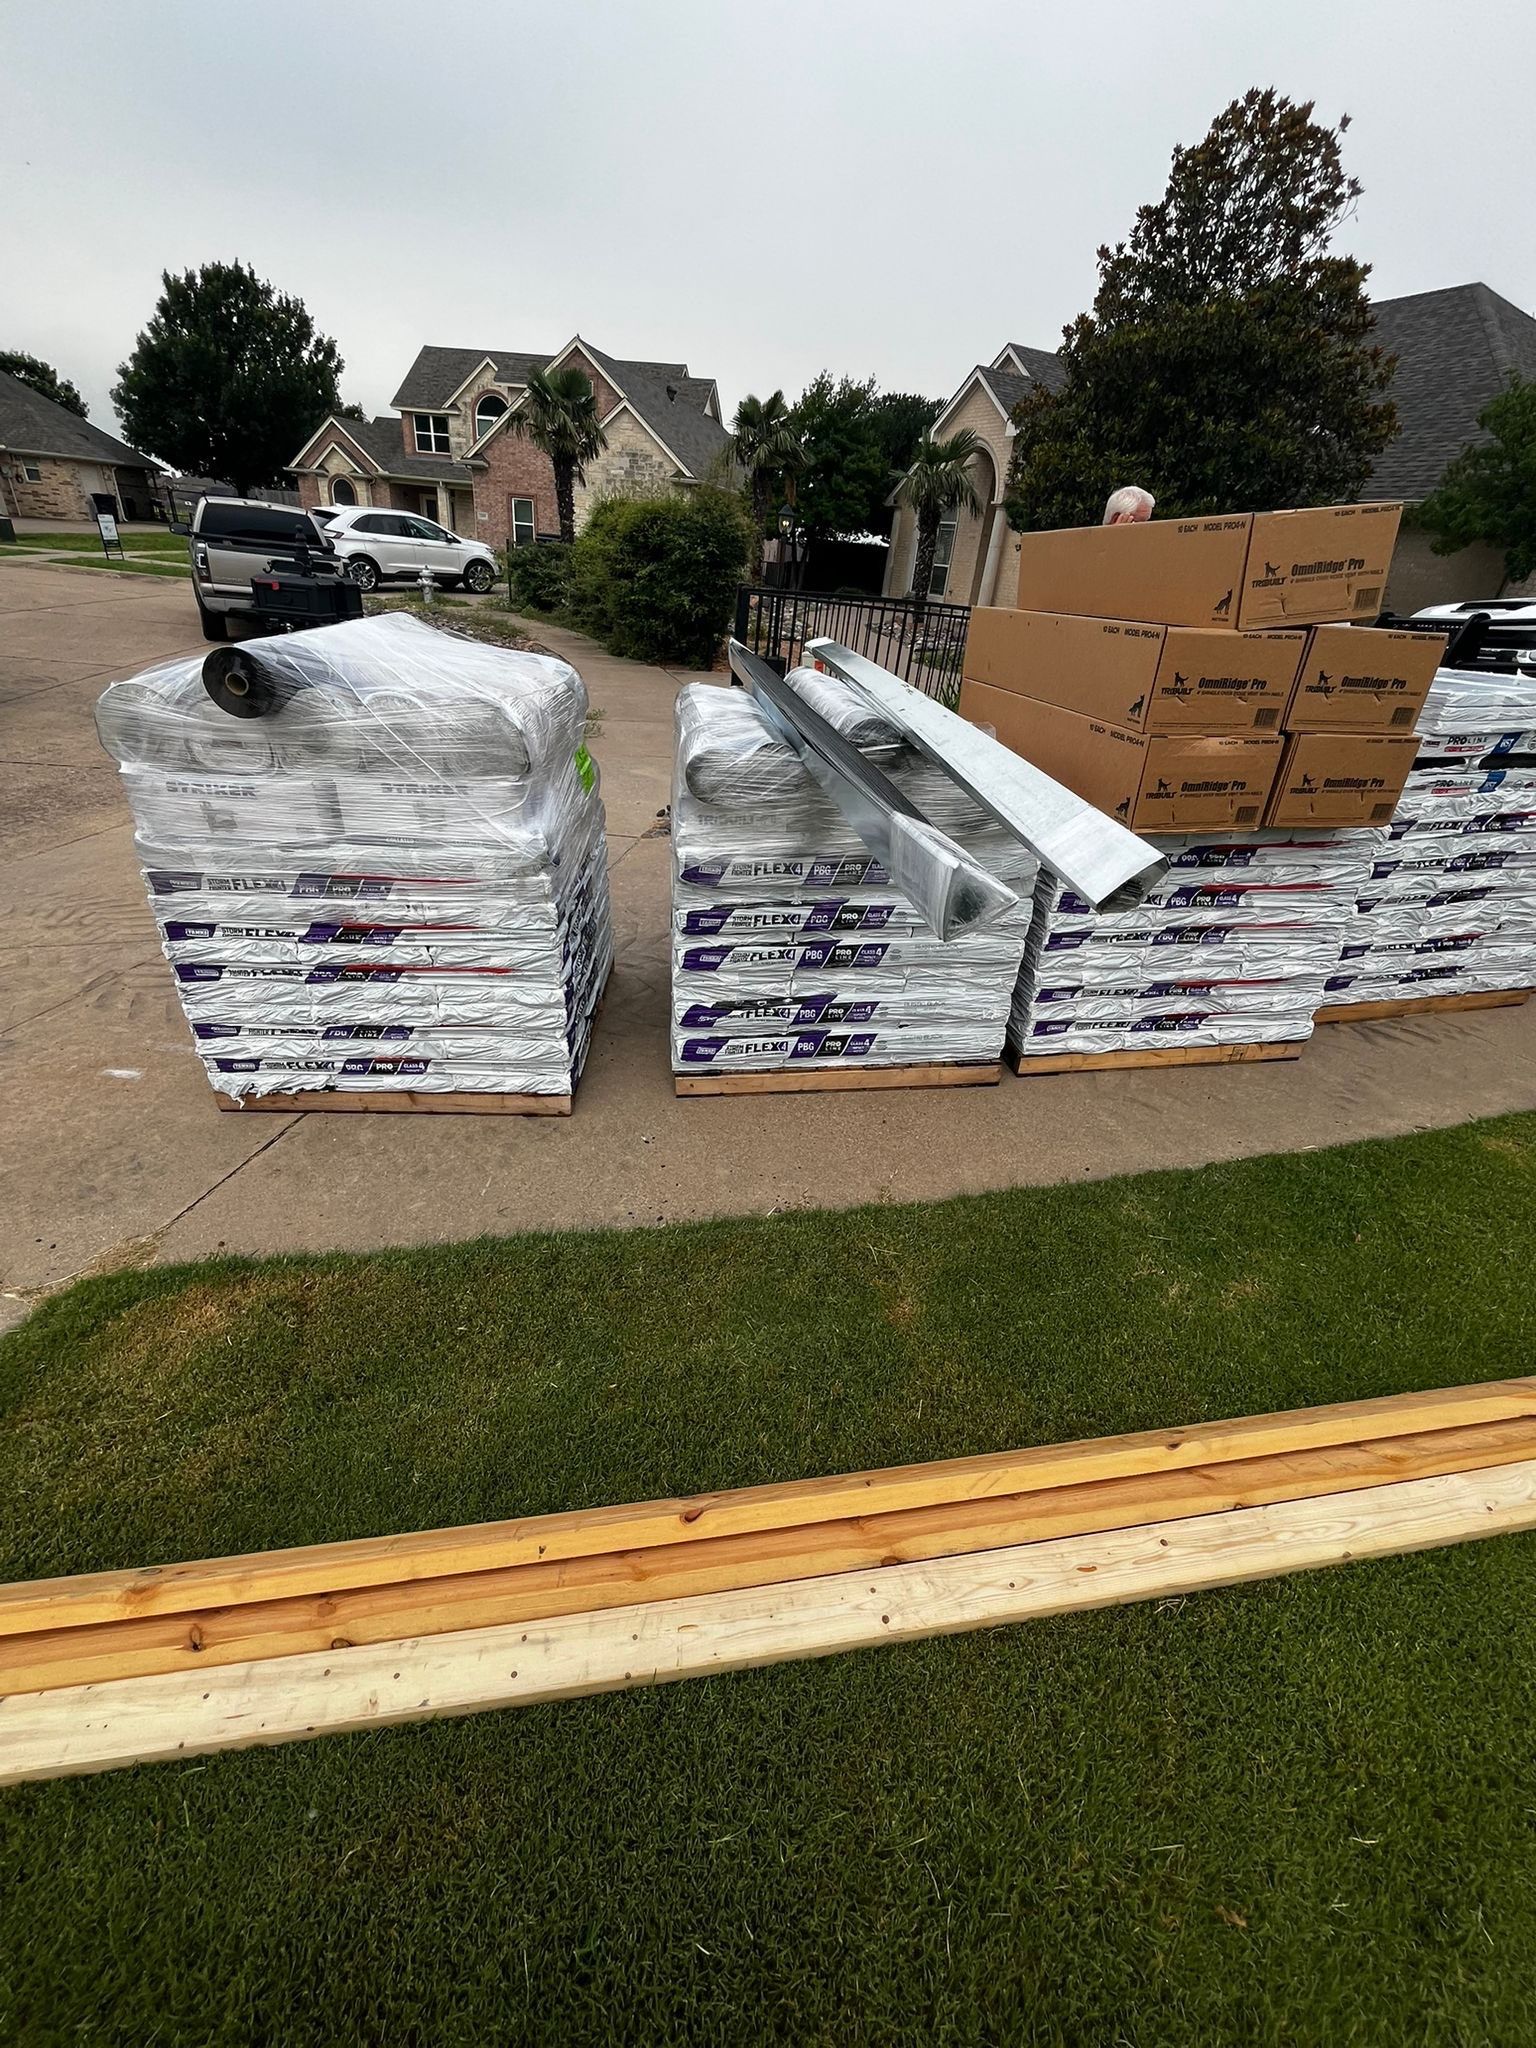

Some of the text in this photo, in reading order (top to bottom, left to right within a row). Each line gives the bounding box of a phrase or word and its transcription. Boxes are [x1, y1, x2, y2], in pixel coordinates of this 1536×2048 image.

[1184, 524, 1199, 533] EACH
[1203, 522, 1222, 532] MODEL
[1347, 558, 1365, 571] Pro
[1252, 577, 1287, 588] TRIBUILT
[1108, 627, 1120, 635] EACH
[1124, 628, 1141, 637] MODEL
[1198, 677, 1267, 691] OmniRidge Pro
[1390, 678, 1407, 690] Pro
[1161, 687, 1194, 696] TRIBUILT
[1094, 725, 1106, 734] EACH
[1110, 730, 1126, 742] MODEL
[1181, 780, 1246, 793] OmniRidge Pro
[1370, 778, 1385, 788] Pro
[166, 781, 257, 798] STRIKER
[814, 865, 831, 875] PBG
[1171, 896, 1187, 906] PBG
[805, 950, 823, 960] PBG
[876, 947, 883, 956] 4
[800, 1009, 816, 1018] PBG
[798, 1042, 815, 1051] PBG
[376, 1063, 394, 1071] PRO
